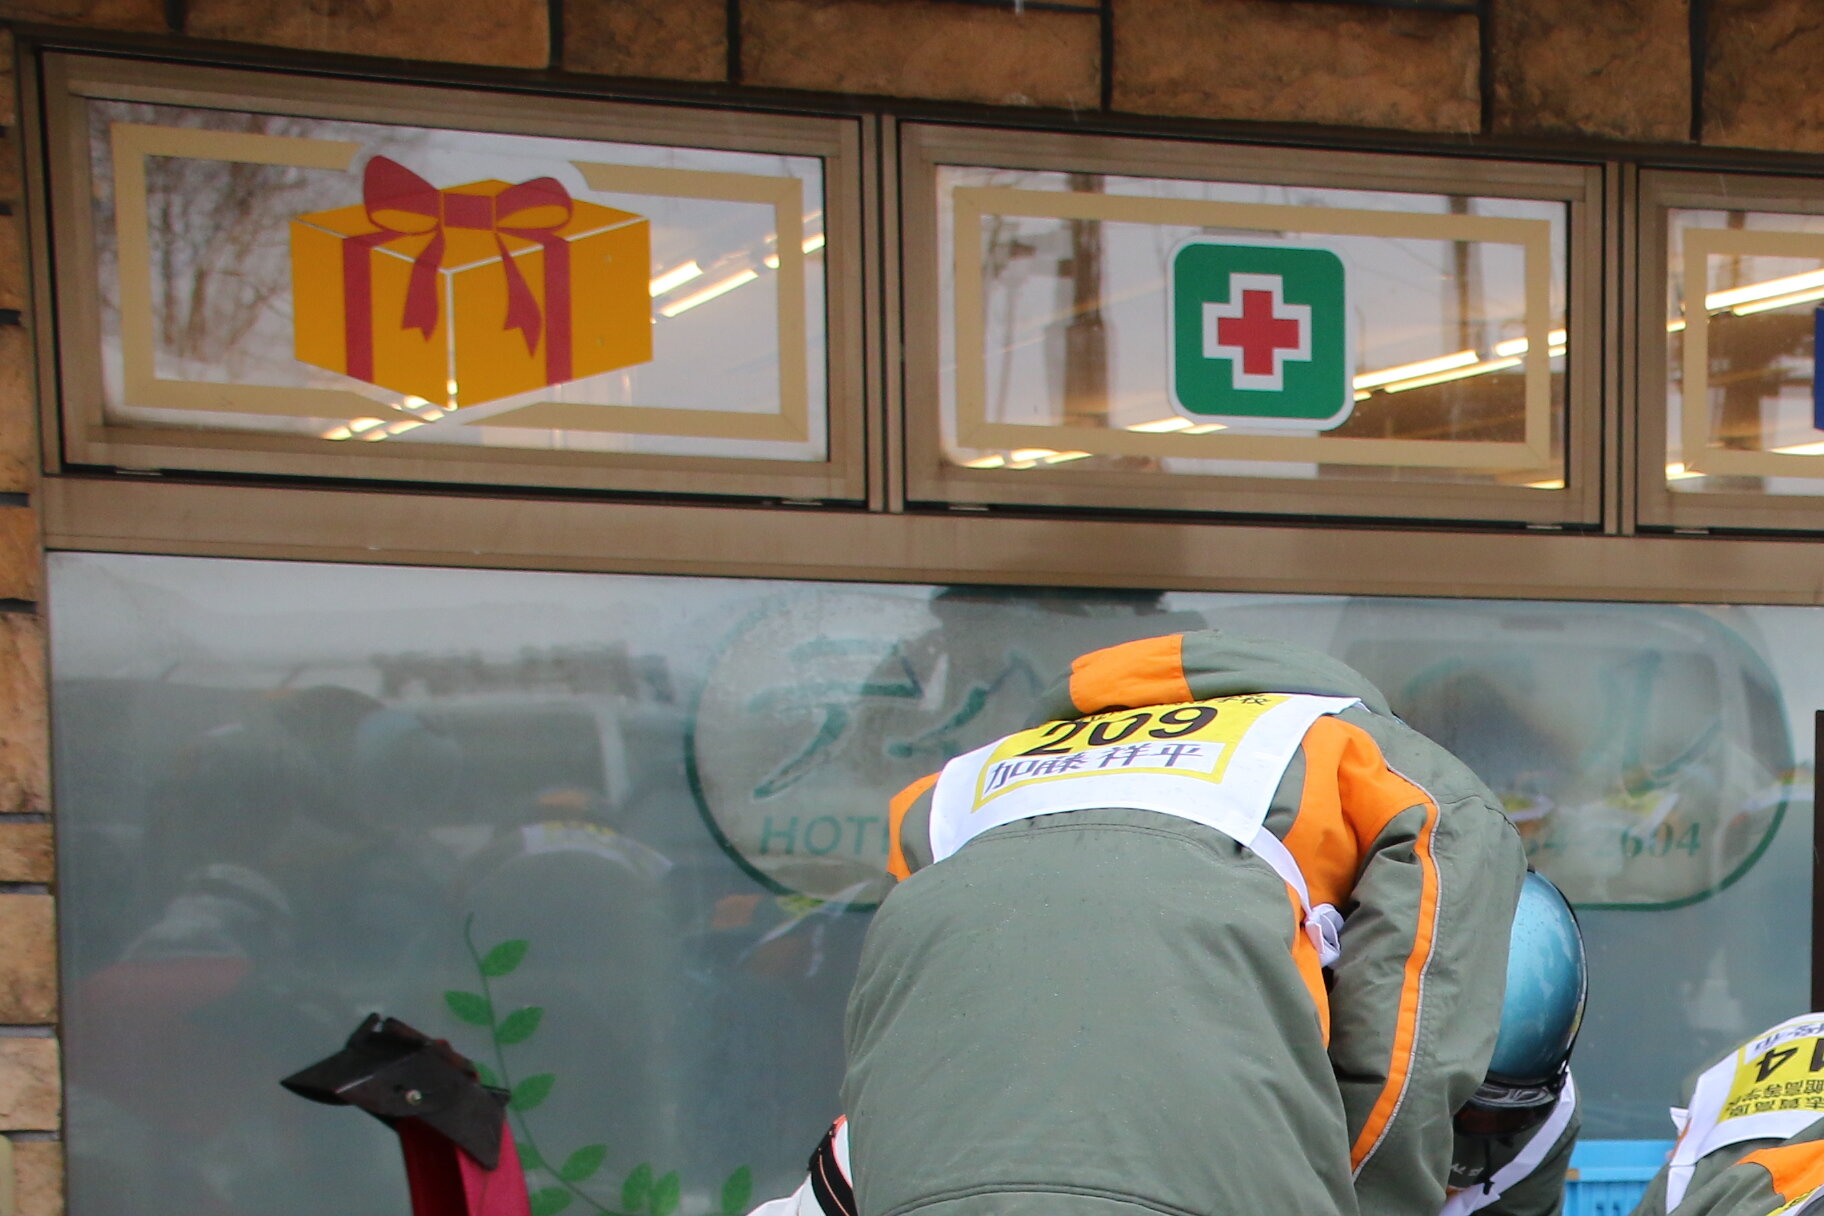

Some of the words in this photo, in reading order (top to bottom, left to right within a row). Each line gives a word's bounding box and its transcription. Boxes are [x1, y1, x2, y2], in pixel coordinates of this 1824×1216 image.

[1016, 704, 1219, 757] 209
[984, 755, 1089, 795] 加藤
[1097, 742, 1206, 770] 祥平
